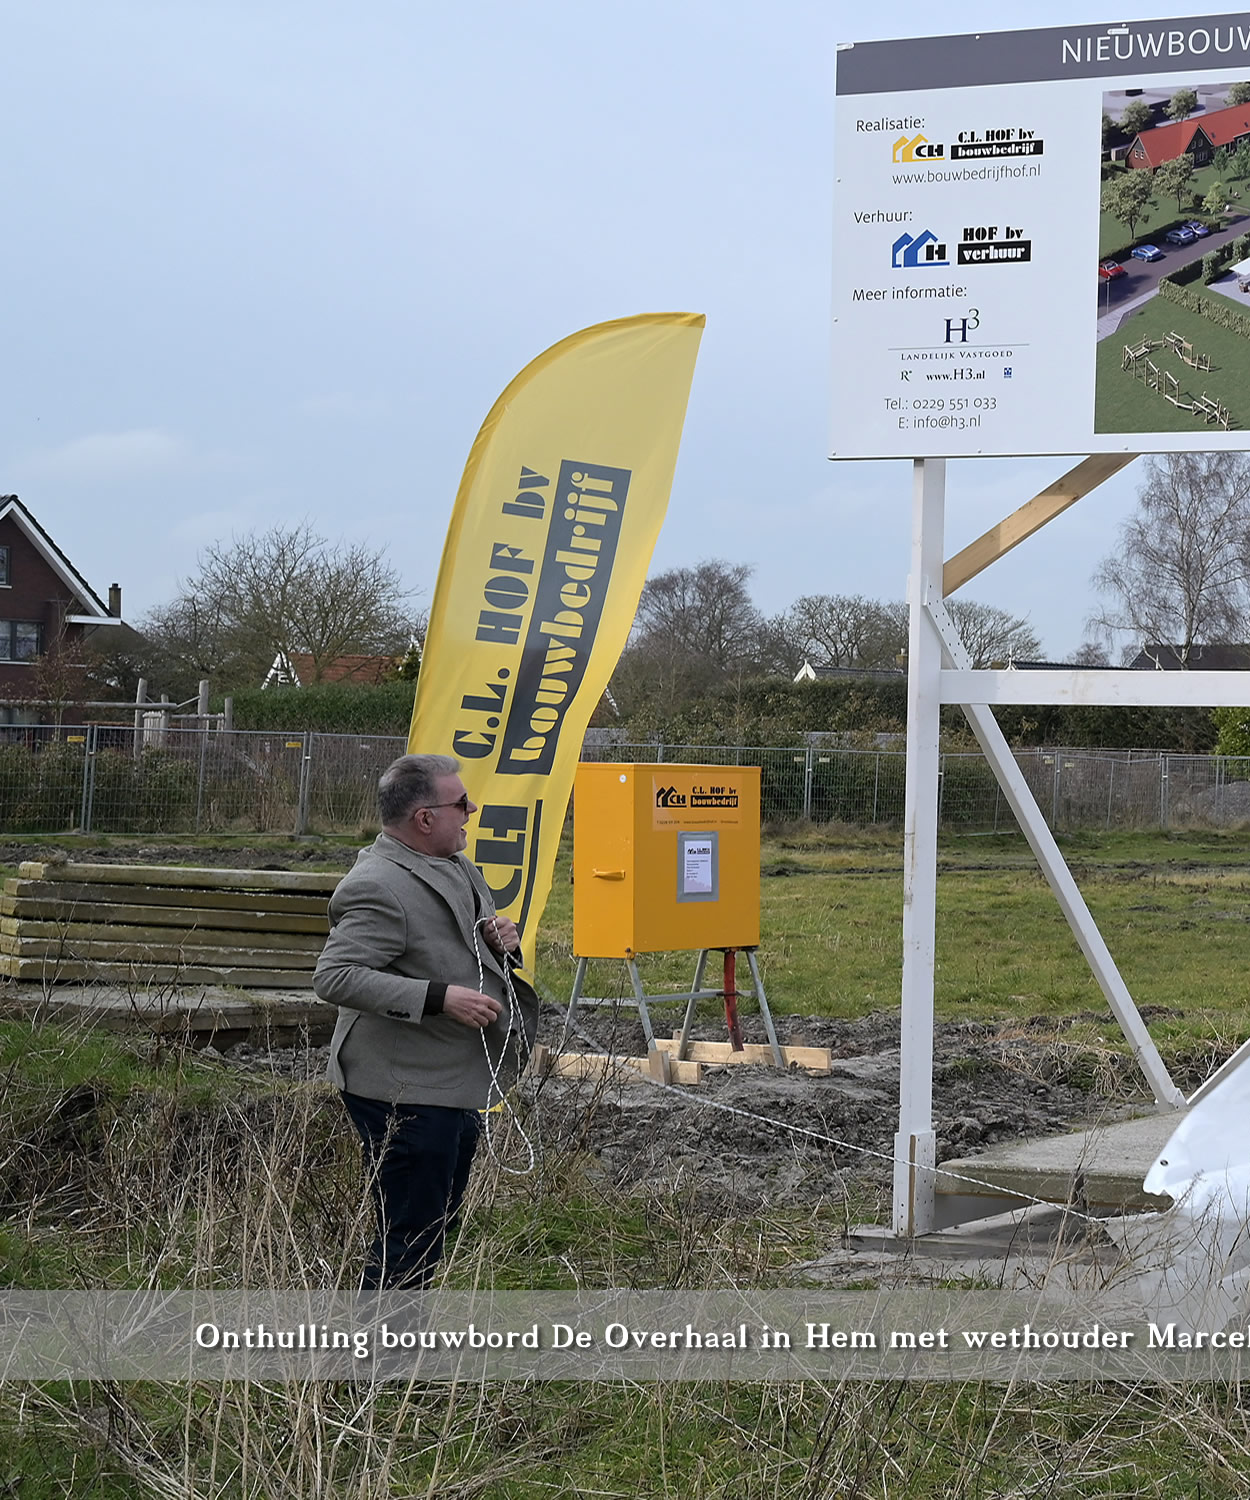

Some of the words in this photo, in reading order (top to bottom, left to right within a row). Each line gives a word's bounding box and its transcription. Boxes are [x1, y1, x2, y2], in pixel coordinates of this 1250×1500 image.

[856, 116, 926, 132] Realisatie:
[957, 130, 983, 143] C.L.
[985, 128, 1015, 142] HOF
[1018, 128, 1035, 140] bv
[915, 144, 944, 158] CH
[957, 141, 1037, 157] bouwbedrijf
[892, 163, 1041, 185] www.bouwbedrijfhof.nl
[854, 210, 913, 224] Verhuur:
[963, 226, 998, 241] HOF
[1005, 226, 1024, 240] bv
[962, 245, 1026, 262] verhuur
[852, 288, 887, 301] Meer
[892, 284, 967, 300] informatie:
[901, 351, 955, 361] LANDELIJK
[959, 350, 1013, 360] VASTGOED
[926, 367, 986, 382] www.H3.nl
[884, 397, 909, 410] Tel.:
[912, 399, 945, 411] 0229
[949, 398, 969, 411] 551
[973, 397, 997, 410] 033
[898, 416, 909, 429] E:
[913, 414, 981, 430] info@h3.nl
[501, 464, 551, 520] bv
[475, 541, 536, 646] HOF
[508, 470, 621, 763] bouwbedrijf
[452, 666, 511, 760] C.L.
[692, 786, 707, 795] C.L.
[710, 787, 725, 795] HOF
[692, 797, 738, 807] bouwbedrijf
